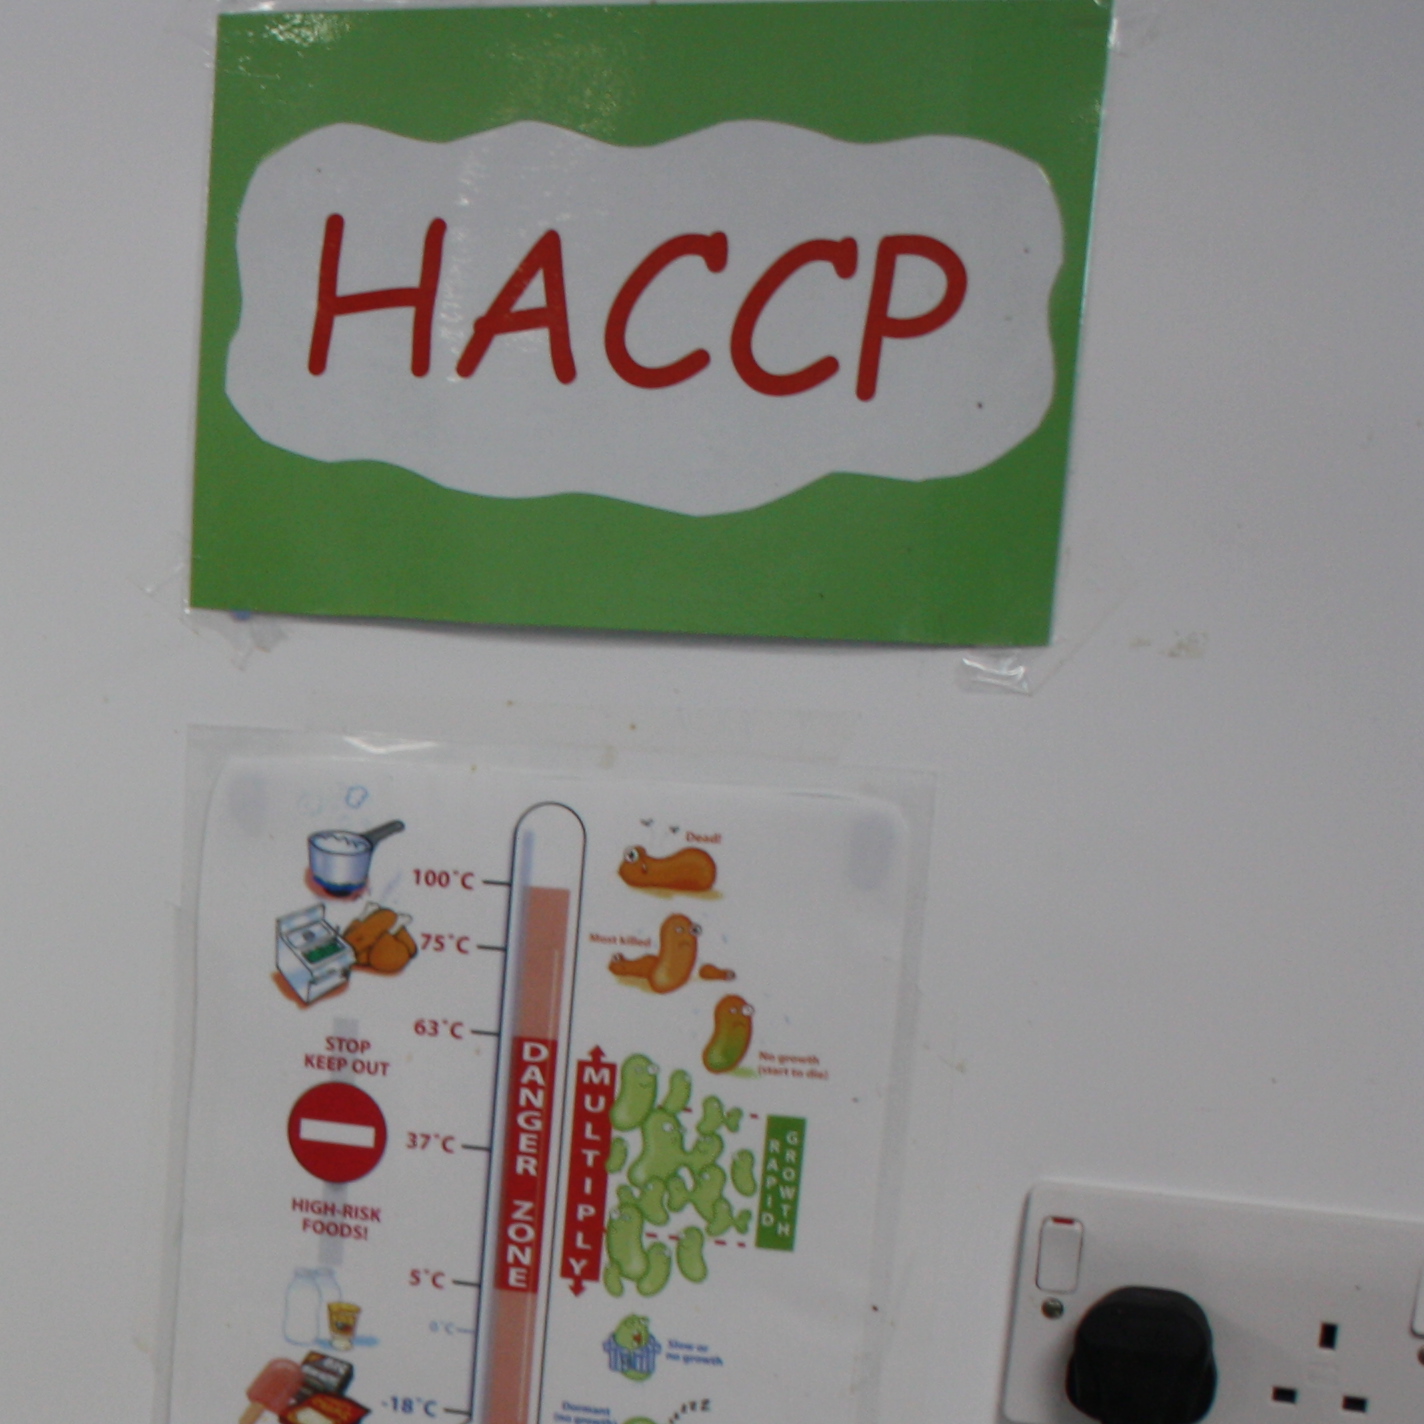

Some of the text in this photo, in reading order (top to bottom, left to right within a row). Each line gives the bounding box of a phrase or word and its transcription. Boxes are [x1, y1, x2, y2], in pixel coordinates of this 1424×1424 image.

[307, 212, 967, 402] HACCP
[412, 868, 475, 891] 100°C
[420, 933, 471, 955] 75°C
[413, 1018, 464, 1040] 63°C
[325, 1035, 372, 1054] STOP
[304, 1053, 390, 1077] KEEP OUT
[406, 1131, 455, 1154] 37°C
[506, 1041, 550, 1289] DANGER ZONE
[568, 1066, 611, 1276] MULTIPLY
[760, 1138, 781, 1227] RAPID
[776, 1130, 799, 1237] GROWTH
[291, 1197, 381, 1223] HIGH-RISK
[302, 1217, 368, 1242] FOODS!
[409, 1268, 446, 1290] 5°C
[380, 1395, 438, 1419] -18°C
